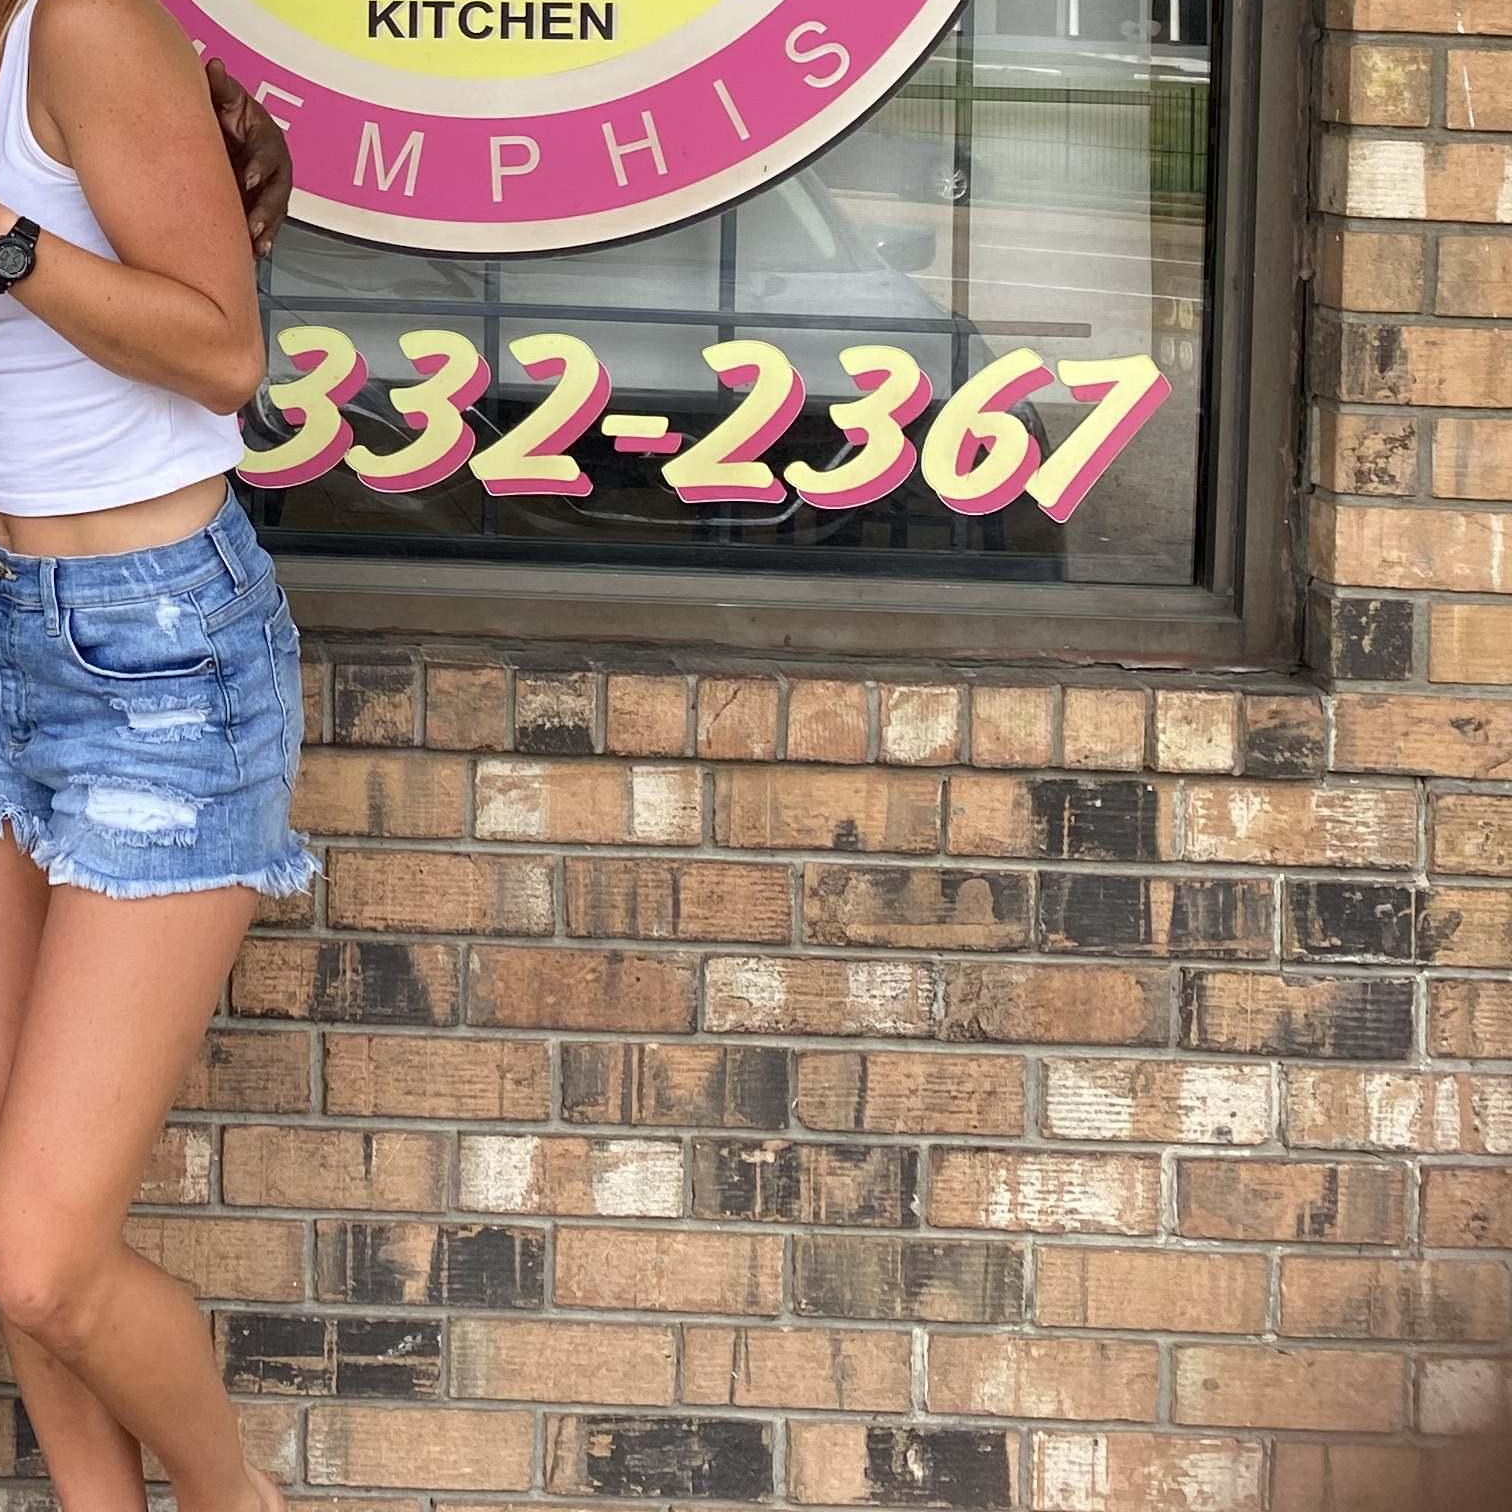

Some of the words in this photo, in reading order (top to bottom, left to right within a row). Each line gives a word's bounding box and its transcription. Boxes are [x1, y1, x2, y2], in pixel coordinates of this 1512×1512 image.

[192, 20, 852, 203] MPHIS
[368, 0, 614, 41] KITCHEN
[236, 325, 1172, 524] 332-2367
